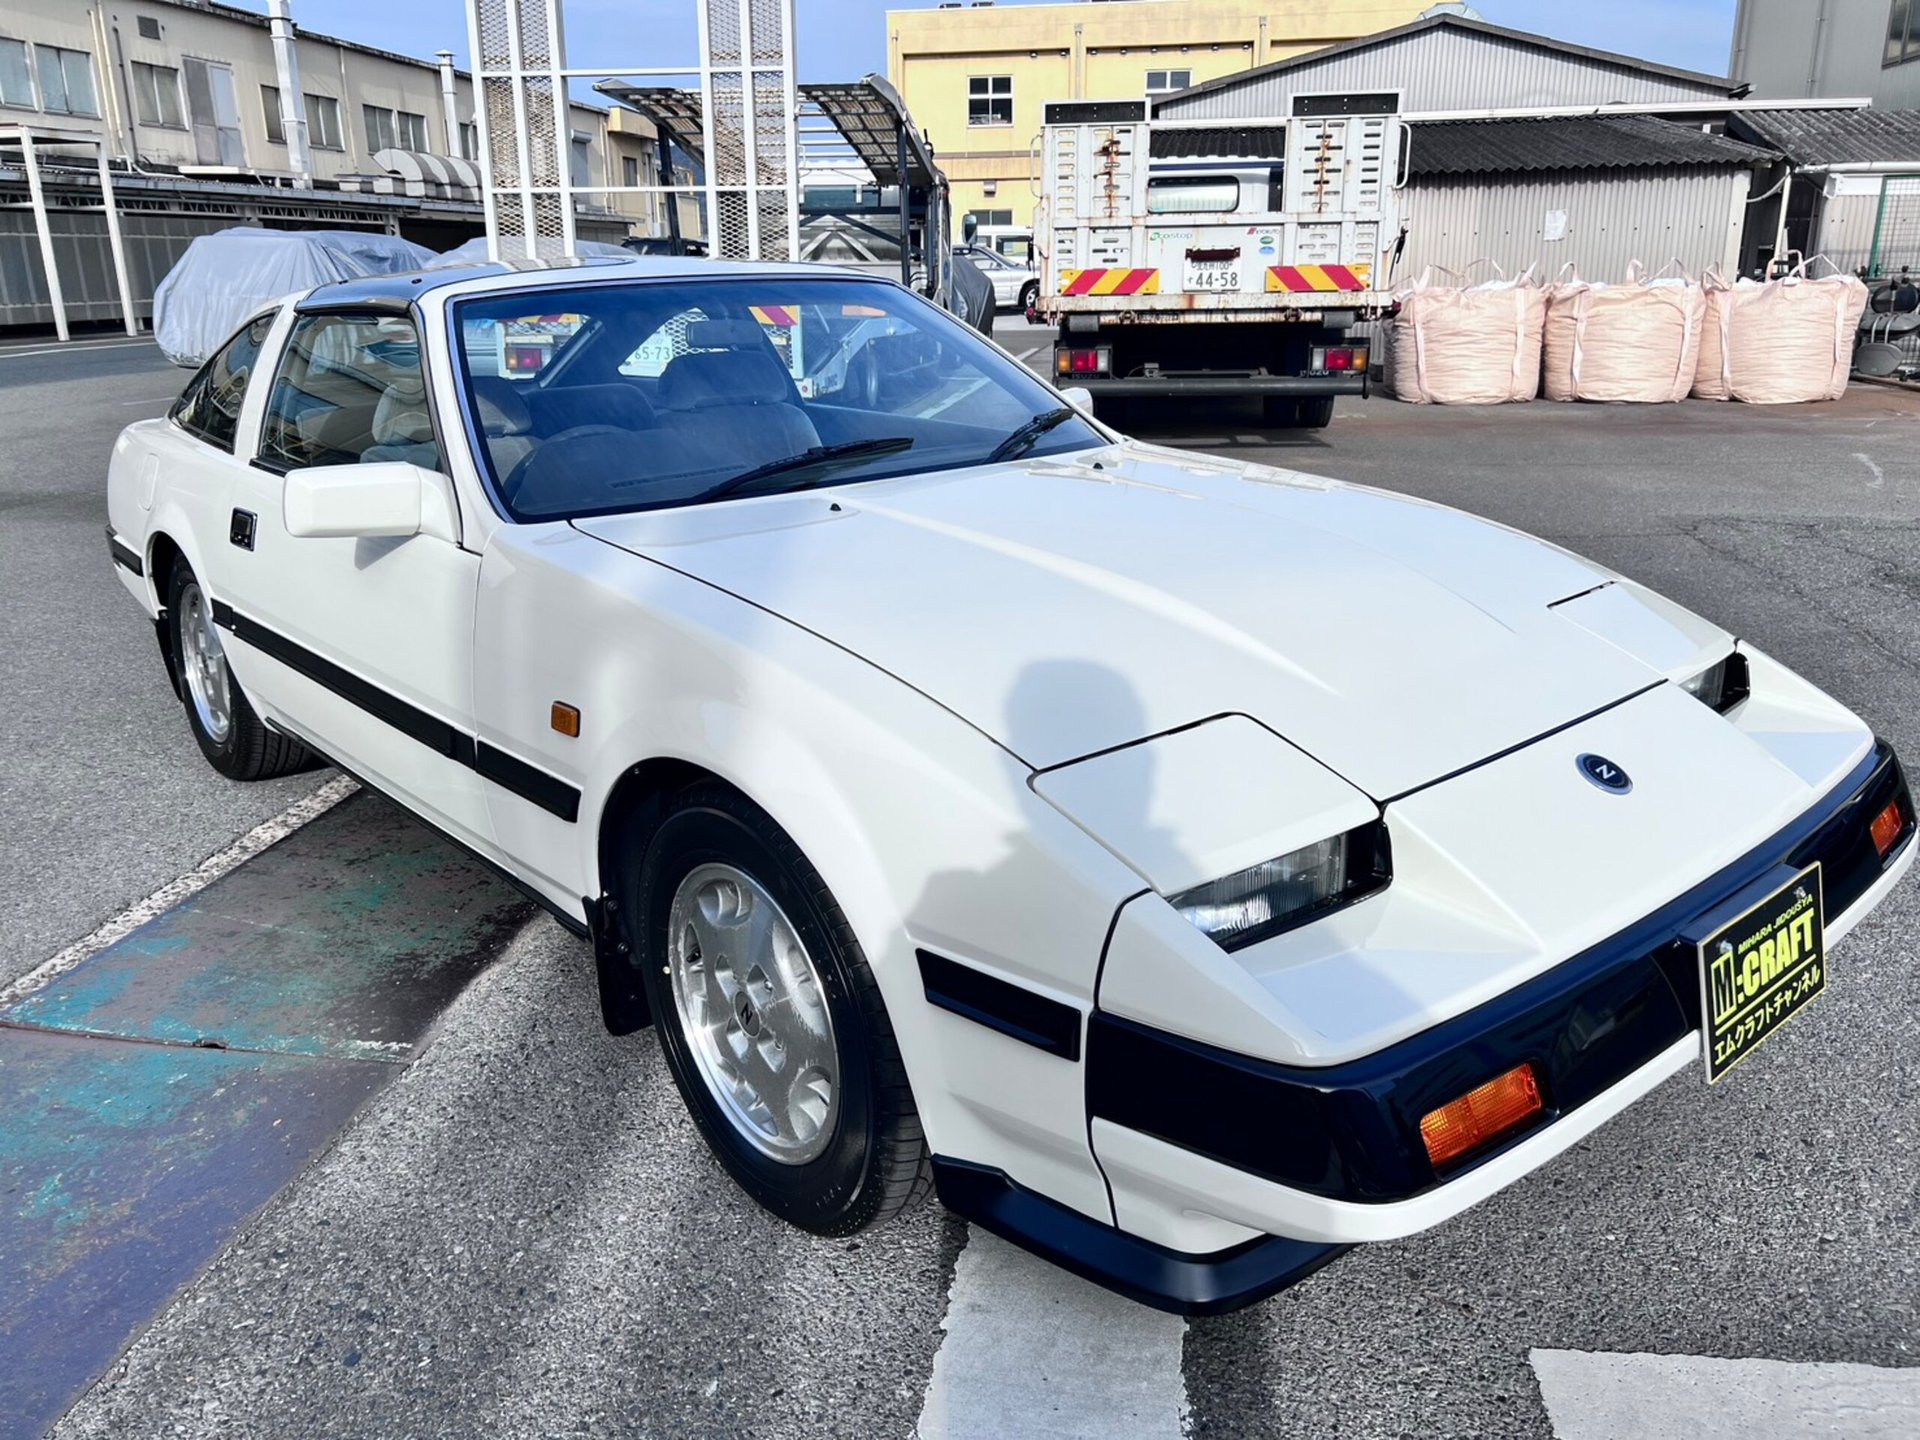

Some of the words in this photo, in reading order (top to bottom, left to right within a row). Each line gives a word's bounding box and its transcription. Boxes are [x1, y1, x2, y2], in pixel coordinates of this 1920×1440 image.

[1195, 272, 1238, 288] 44-58
[1738, 923, 1773, 954] MIHARA
[1773, 893, 1813, 929] JIDOUSYA
[1714, 964, 1821, 1066] エムクラフトチャンネル
